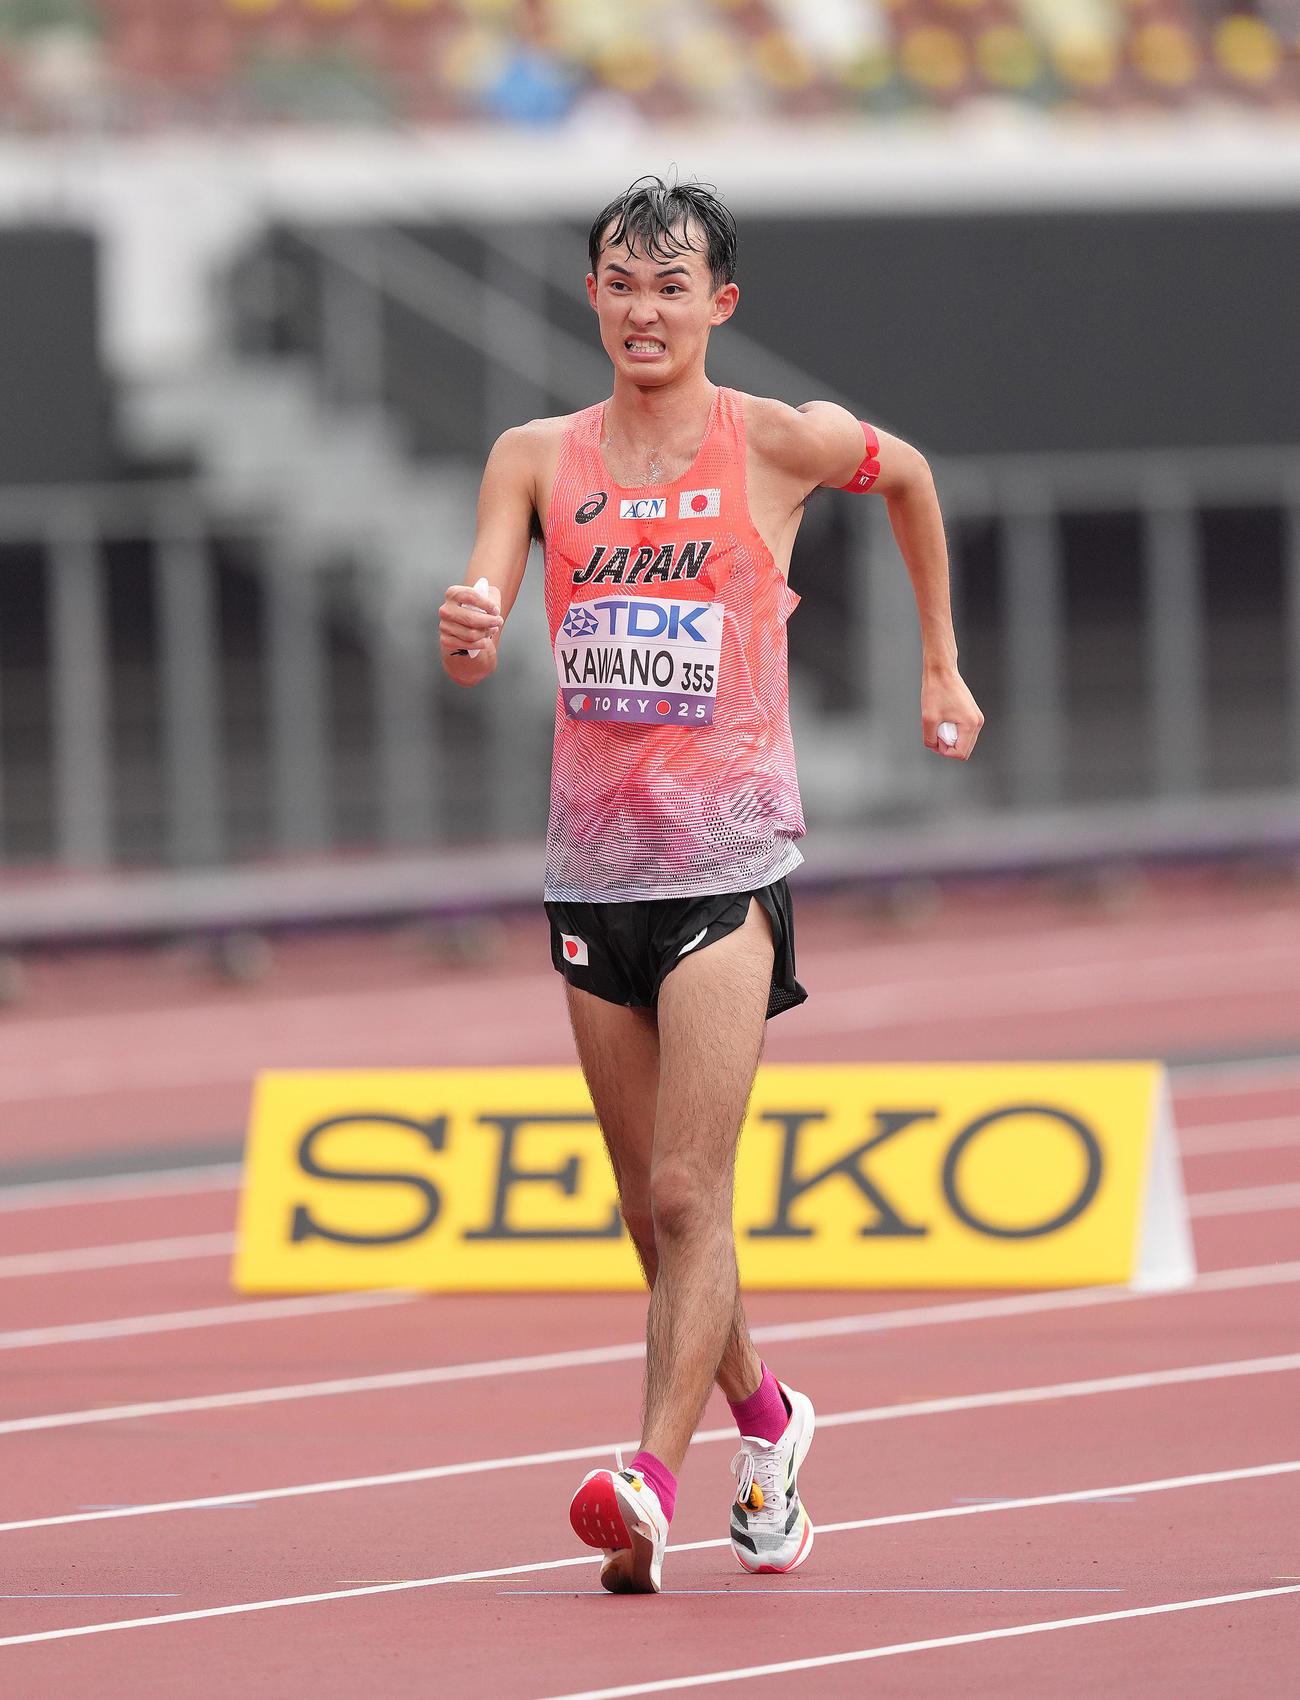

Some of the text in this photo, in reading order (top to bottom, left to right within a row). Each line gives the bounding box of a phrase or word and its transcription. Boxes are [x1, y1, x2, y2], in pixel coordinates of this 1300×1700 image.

[624, 499, 664, 518] ACN
[572, 541, 713, 585] JAPAN
[594, 601, 710, 643] TDK
[561, 648, 715, 693] KAWANO 355
[289, 1105, 1104, 1246] SEKO
